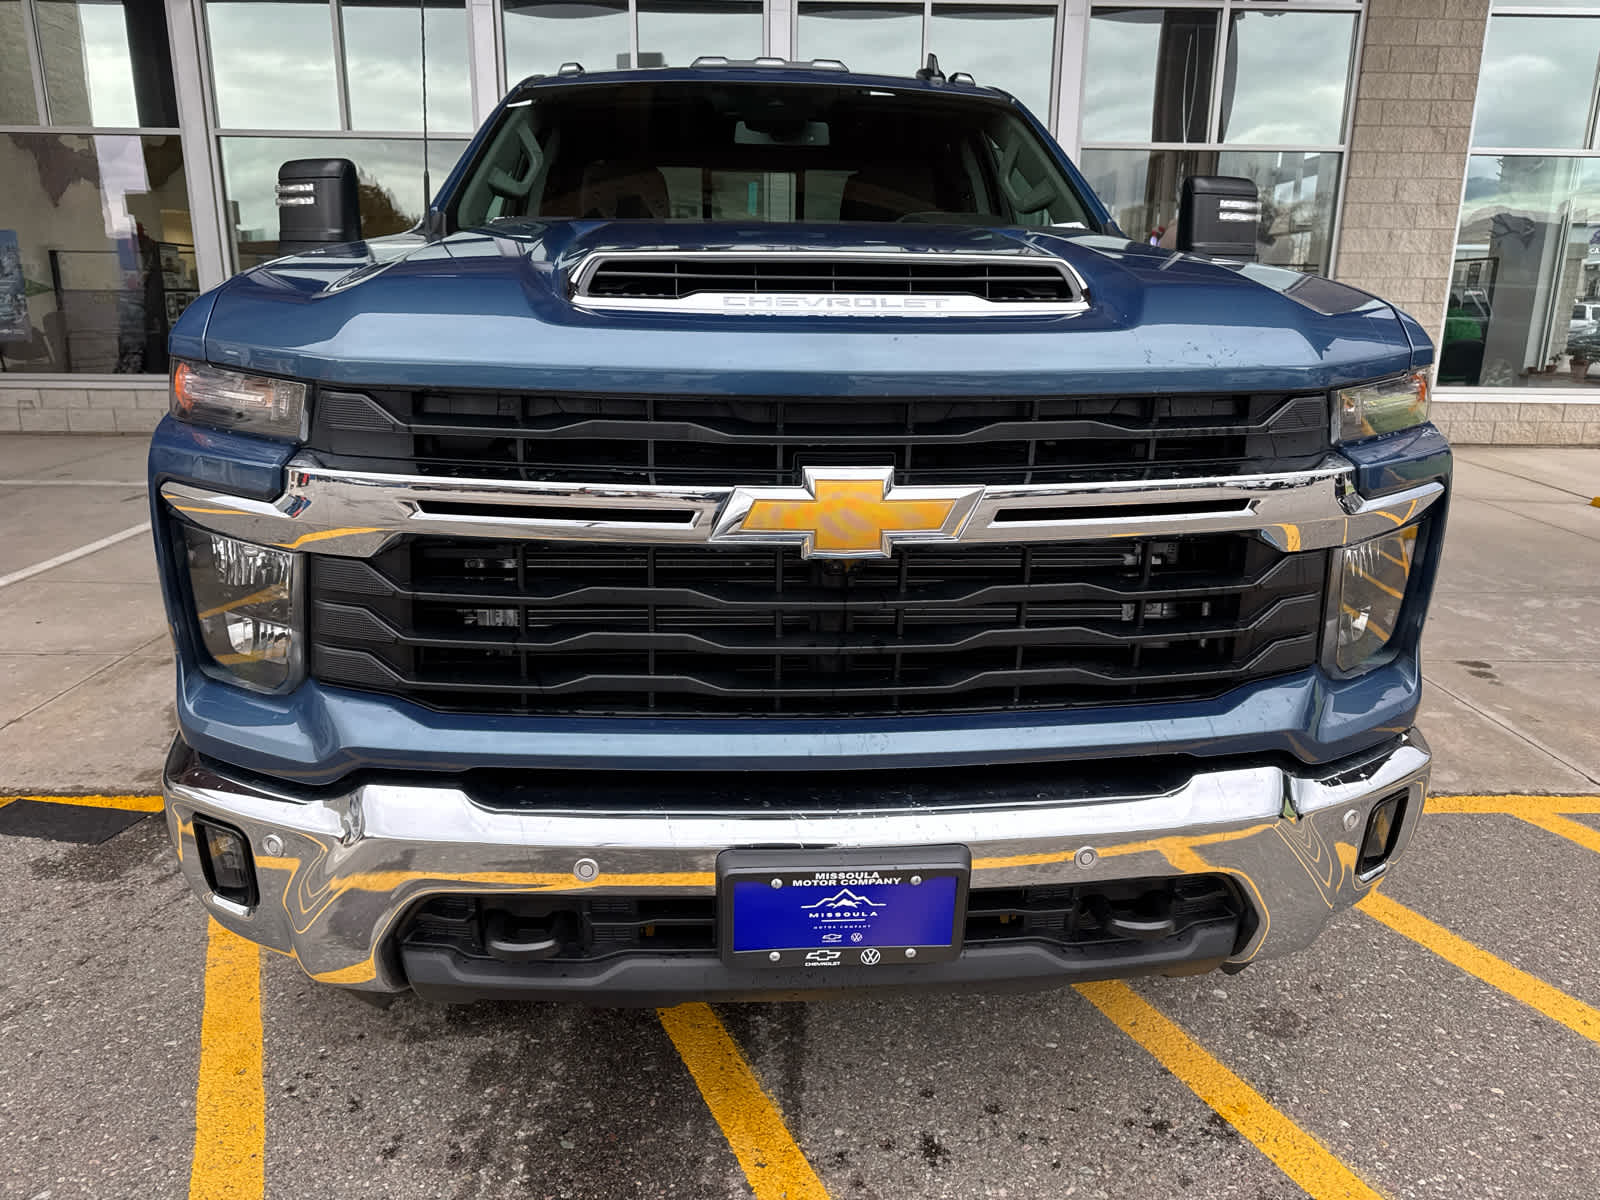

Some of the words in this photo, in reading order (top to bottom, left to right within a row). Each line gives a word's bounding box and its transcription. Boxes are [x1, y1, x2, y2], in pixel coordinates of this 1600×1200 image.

[722, 296, 949, 308] CHEVROLET
[815, 871, 880, 880] MISSOULA
[792, 879, 837, 887] MOTOR
[840, 877, 902, 886] COMPANY
